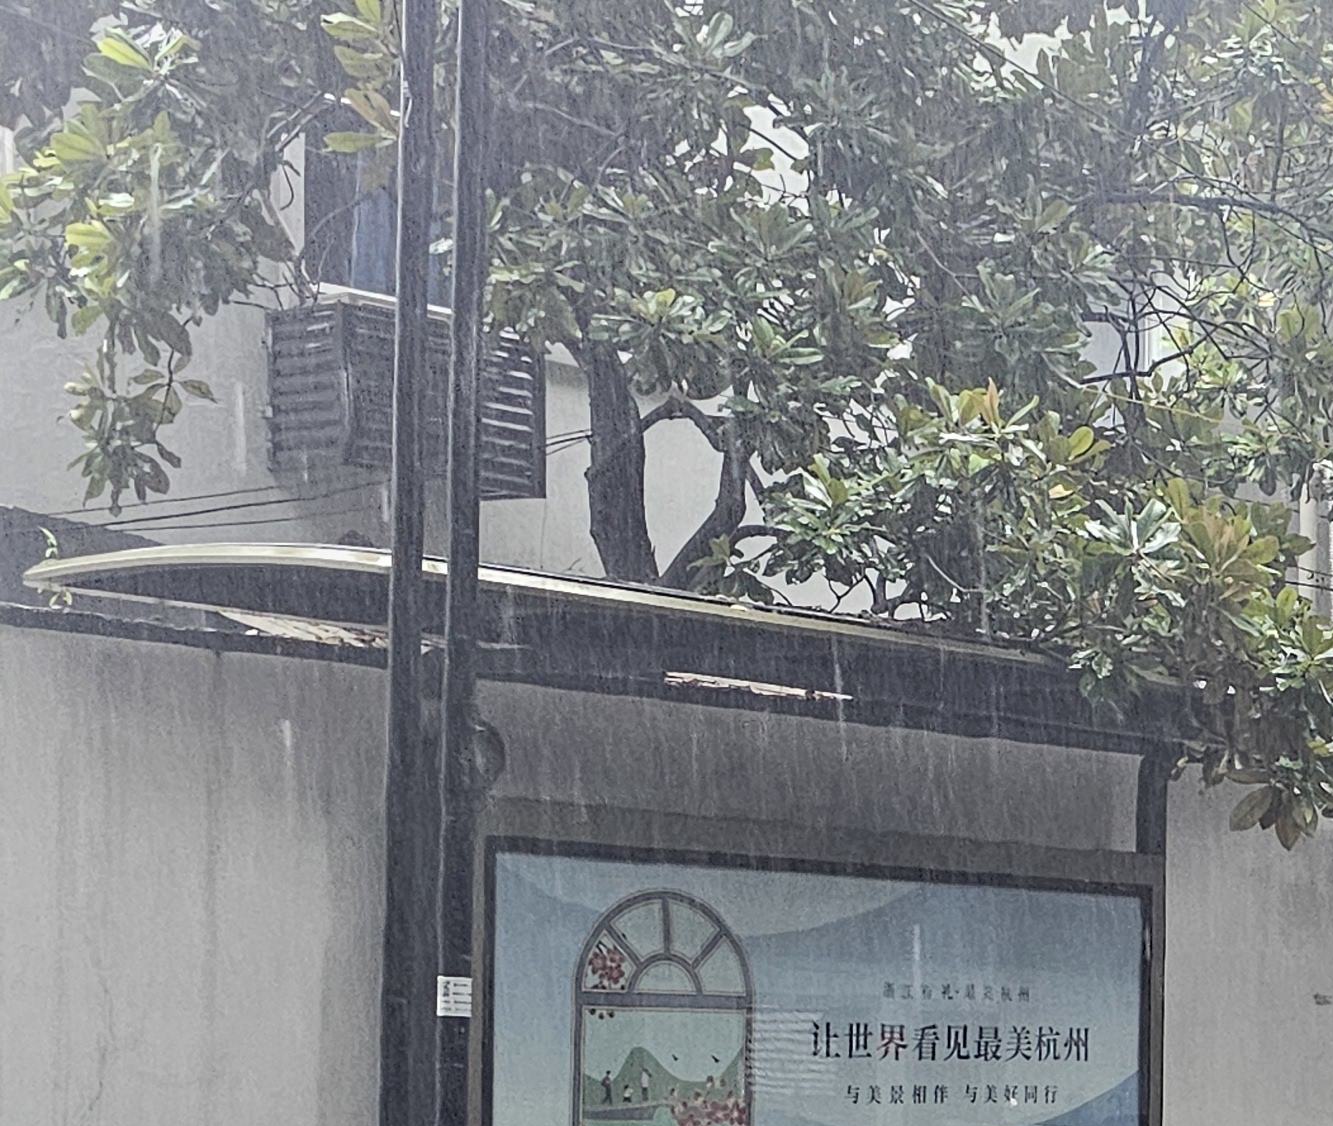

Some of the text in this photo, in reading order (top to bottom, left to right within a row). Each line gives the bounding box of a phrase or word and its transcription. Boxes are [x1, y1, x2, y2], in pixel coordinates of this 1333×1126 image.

[812, 1021, 1090, 1062] 让世界看见最美杭州
[964, 1083, 1059, 1105] 与美好同行
